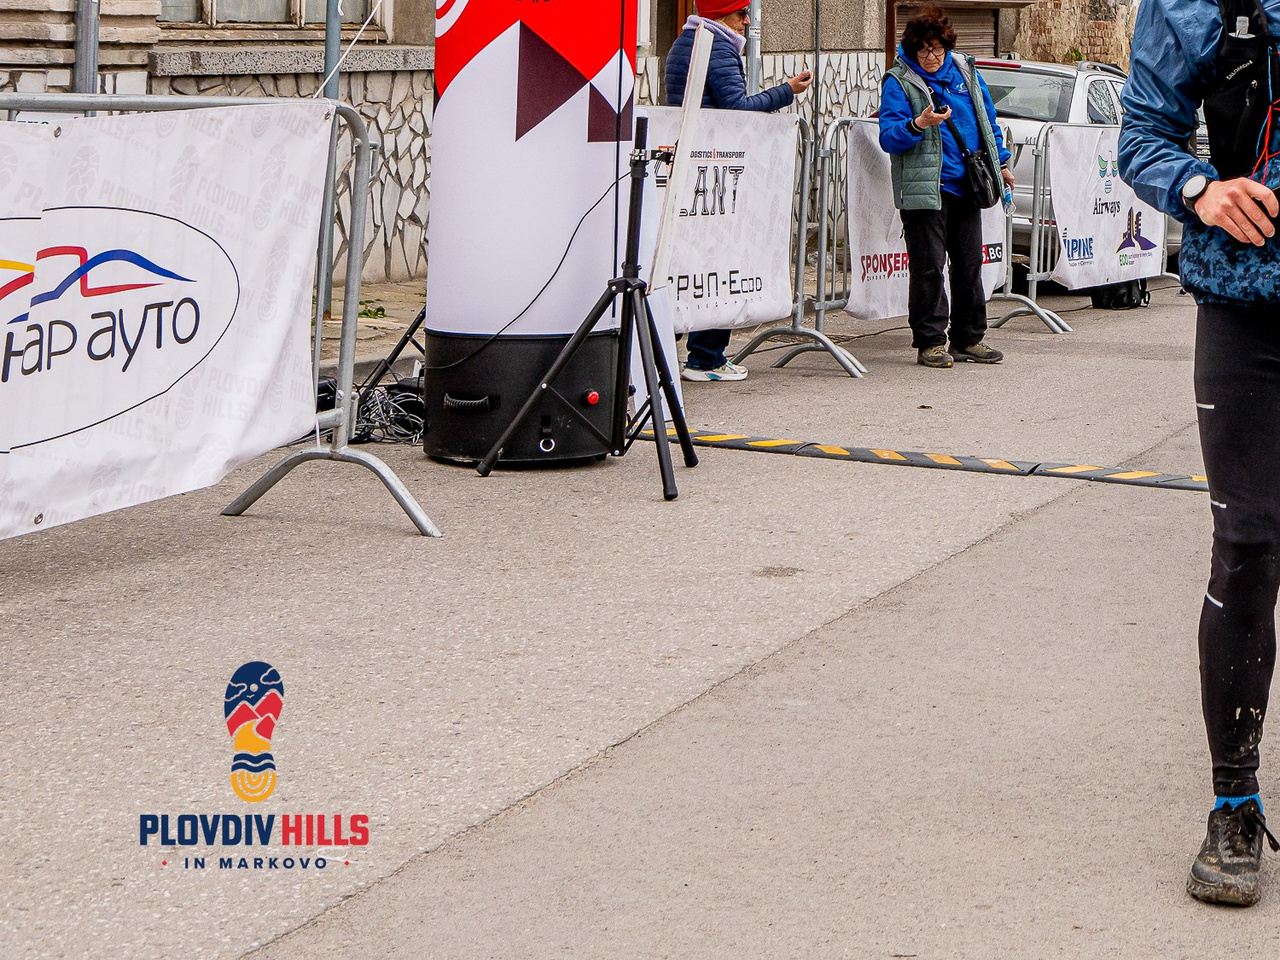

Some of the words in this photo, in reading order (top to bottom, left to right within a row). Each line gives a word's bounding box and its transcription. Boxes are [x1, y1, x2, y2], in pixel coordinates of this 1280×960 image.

[716, 151, 746, 159] TRANSPORT
[1092, 197, 1121, 217] Airways
[860, 252, 909, 283] SPONSER
